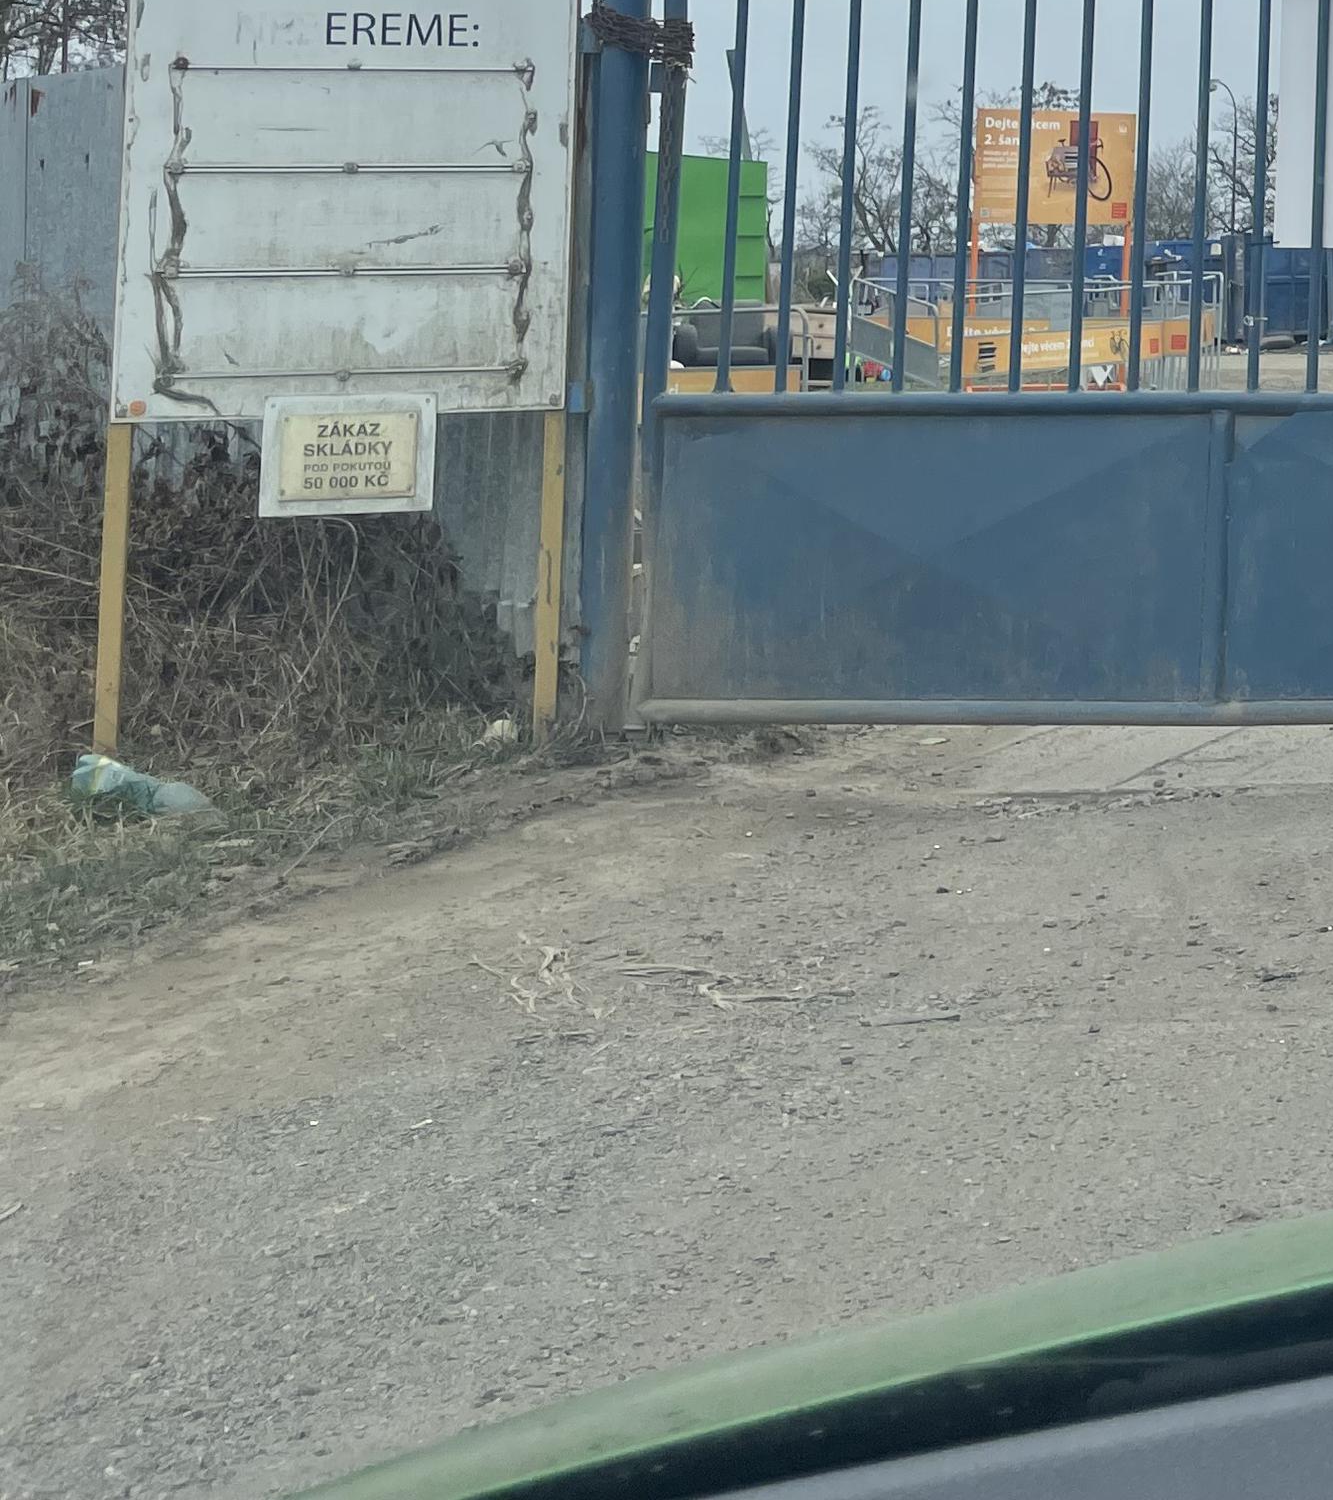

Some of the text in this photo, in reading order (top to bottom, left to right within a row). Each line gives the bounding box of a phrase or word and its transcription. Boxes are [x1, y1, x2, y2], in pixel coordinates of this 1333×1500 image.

[985, 117, 1018, 131] Dejte
[984, 134, 996, 146] 2.
[317, 421, 381, 438] ZÁKAZ
[303, 439, 393, 457] SKLÁDKY
[304, 461, 391, 473] POD POKUTOU
[303, 471, 389, 489] 50 000 KČ
